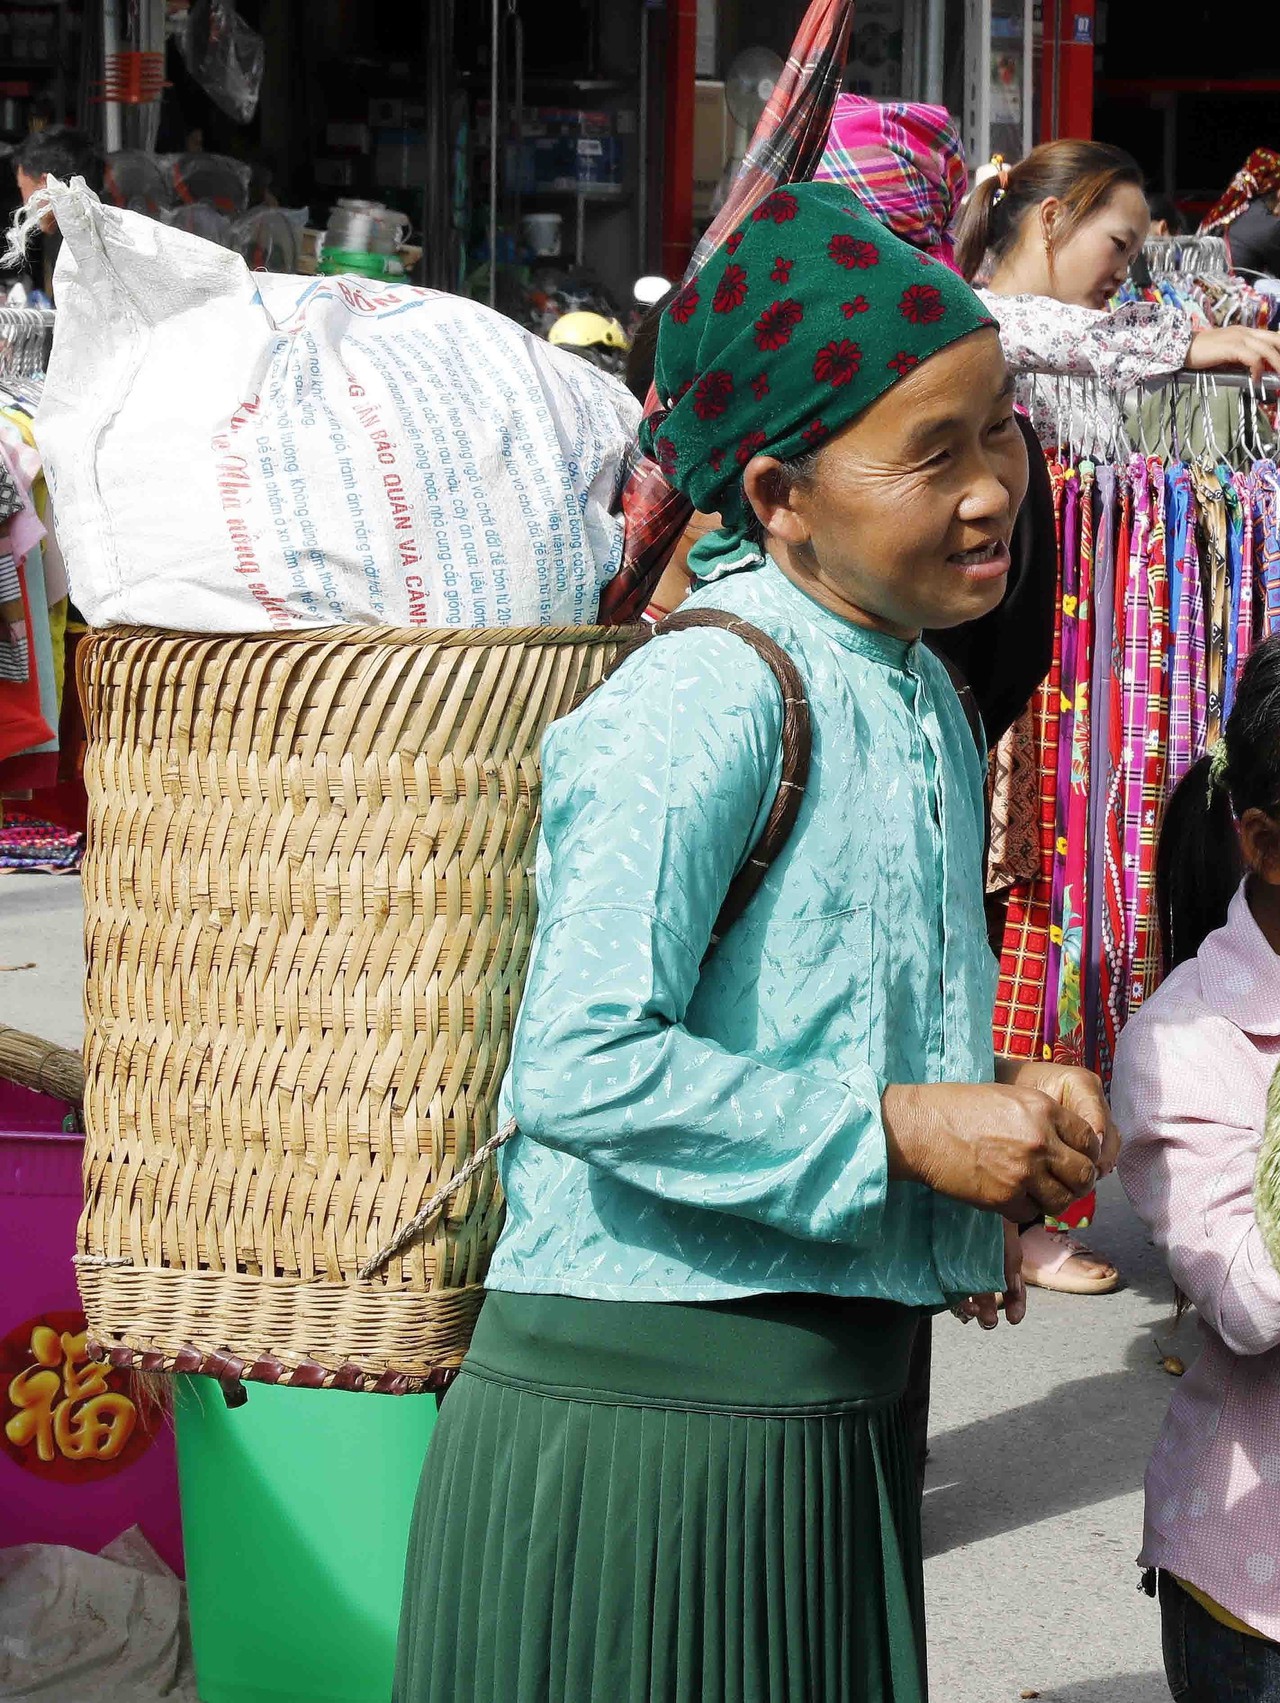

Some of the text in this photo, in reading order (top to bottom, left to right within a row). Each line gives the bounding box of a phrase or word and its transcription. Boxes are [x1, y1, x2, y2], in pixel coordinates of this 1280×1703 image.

[310, 357, 324, 376] nơi
[346, 493, 363, 517] ánh
[396, 406, 424, 440] khuyến
[412, 443, 432, 470] nông
[453, 430, 474, 459] giống
[496, 426, 514, 457] giống
[260, 456, 279, 479] sản
[290, 478, 311, 517] Không
[368, 430, 398, 465] BẢO
[383, 473, 415, 530] QUẢN
[399, 539, 423, 567] VÀ
[423, 472, 442, 502] hoặc
[439, 447, 455, 465] rau
[452, 500, 470, 521] cây
[429, 505, 446, 528] nhà
[299, 520, 319, 547] dùng
[437, 531, 453, 561] cung
[442, 564, 463, 587] cấp
[5, 1325, 137, 1461] 福
